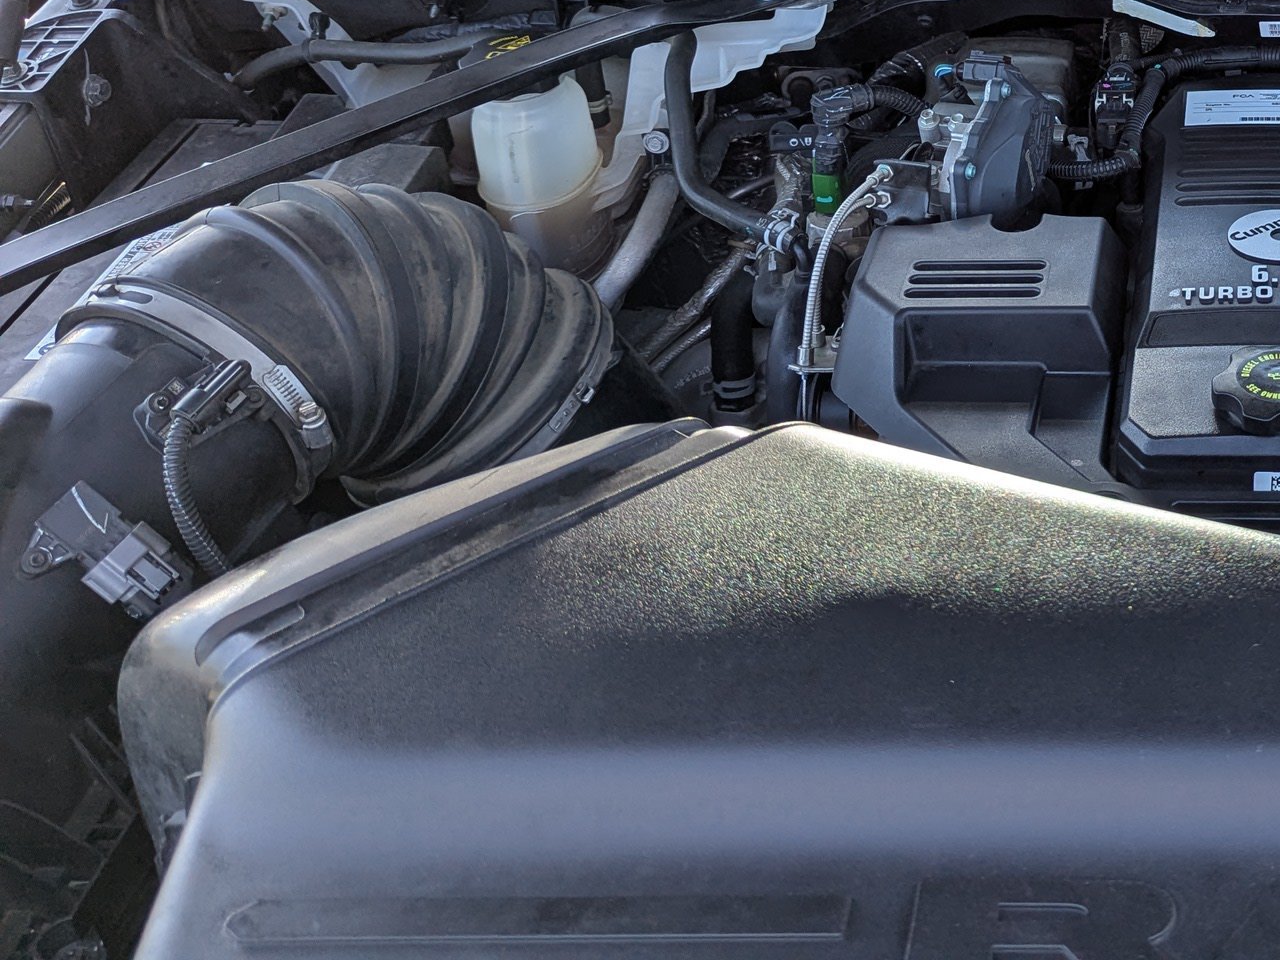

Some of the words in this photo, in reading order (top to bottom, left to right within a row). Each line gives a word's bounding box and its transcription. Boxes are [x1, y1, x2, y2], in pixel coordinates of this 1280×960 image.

[1181, 286, 1274, 303] TURBO
[1241, 360, 1259, 378] DIESEL
[1246, 383, 1262, 394] SEE
